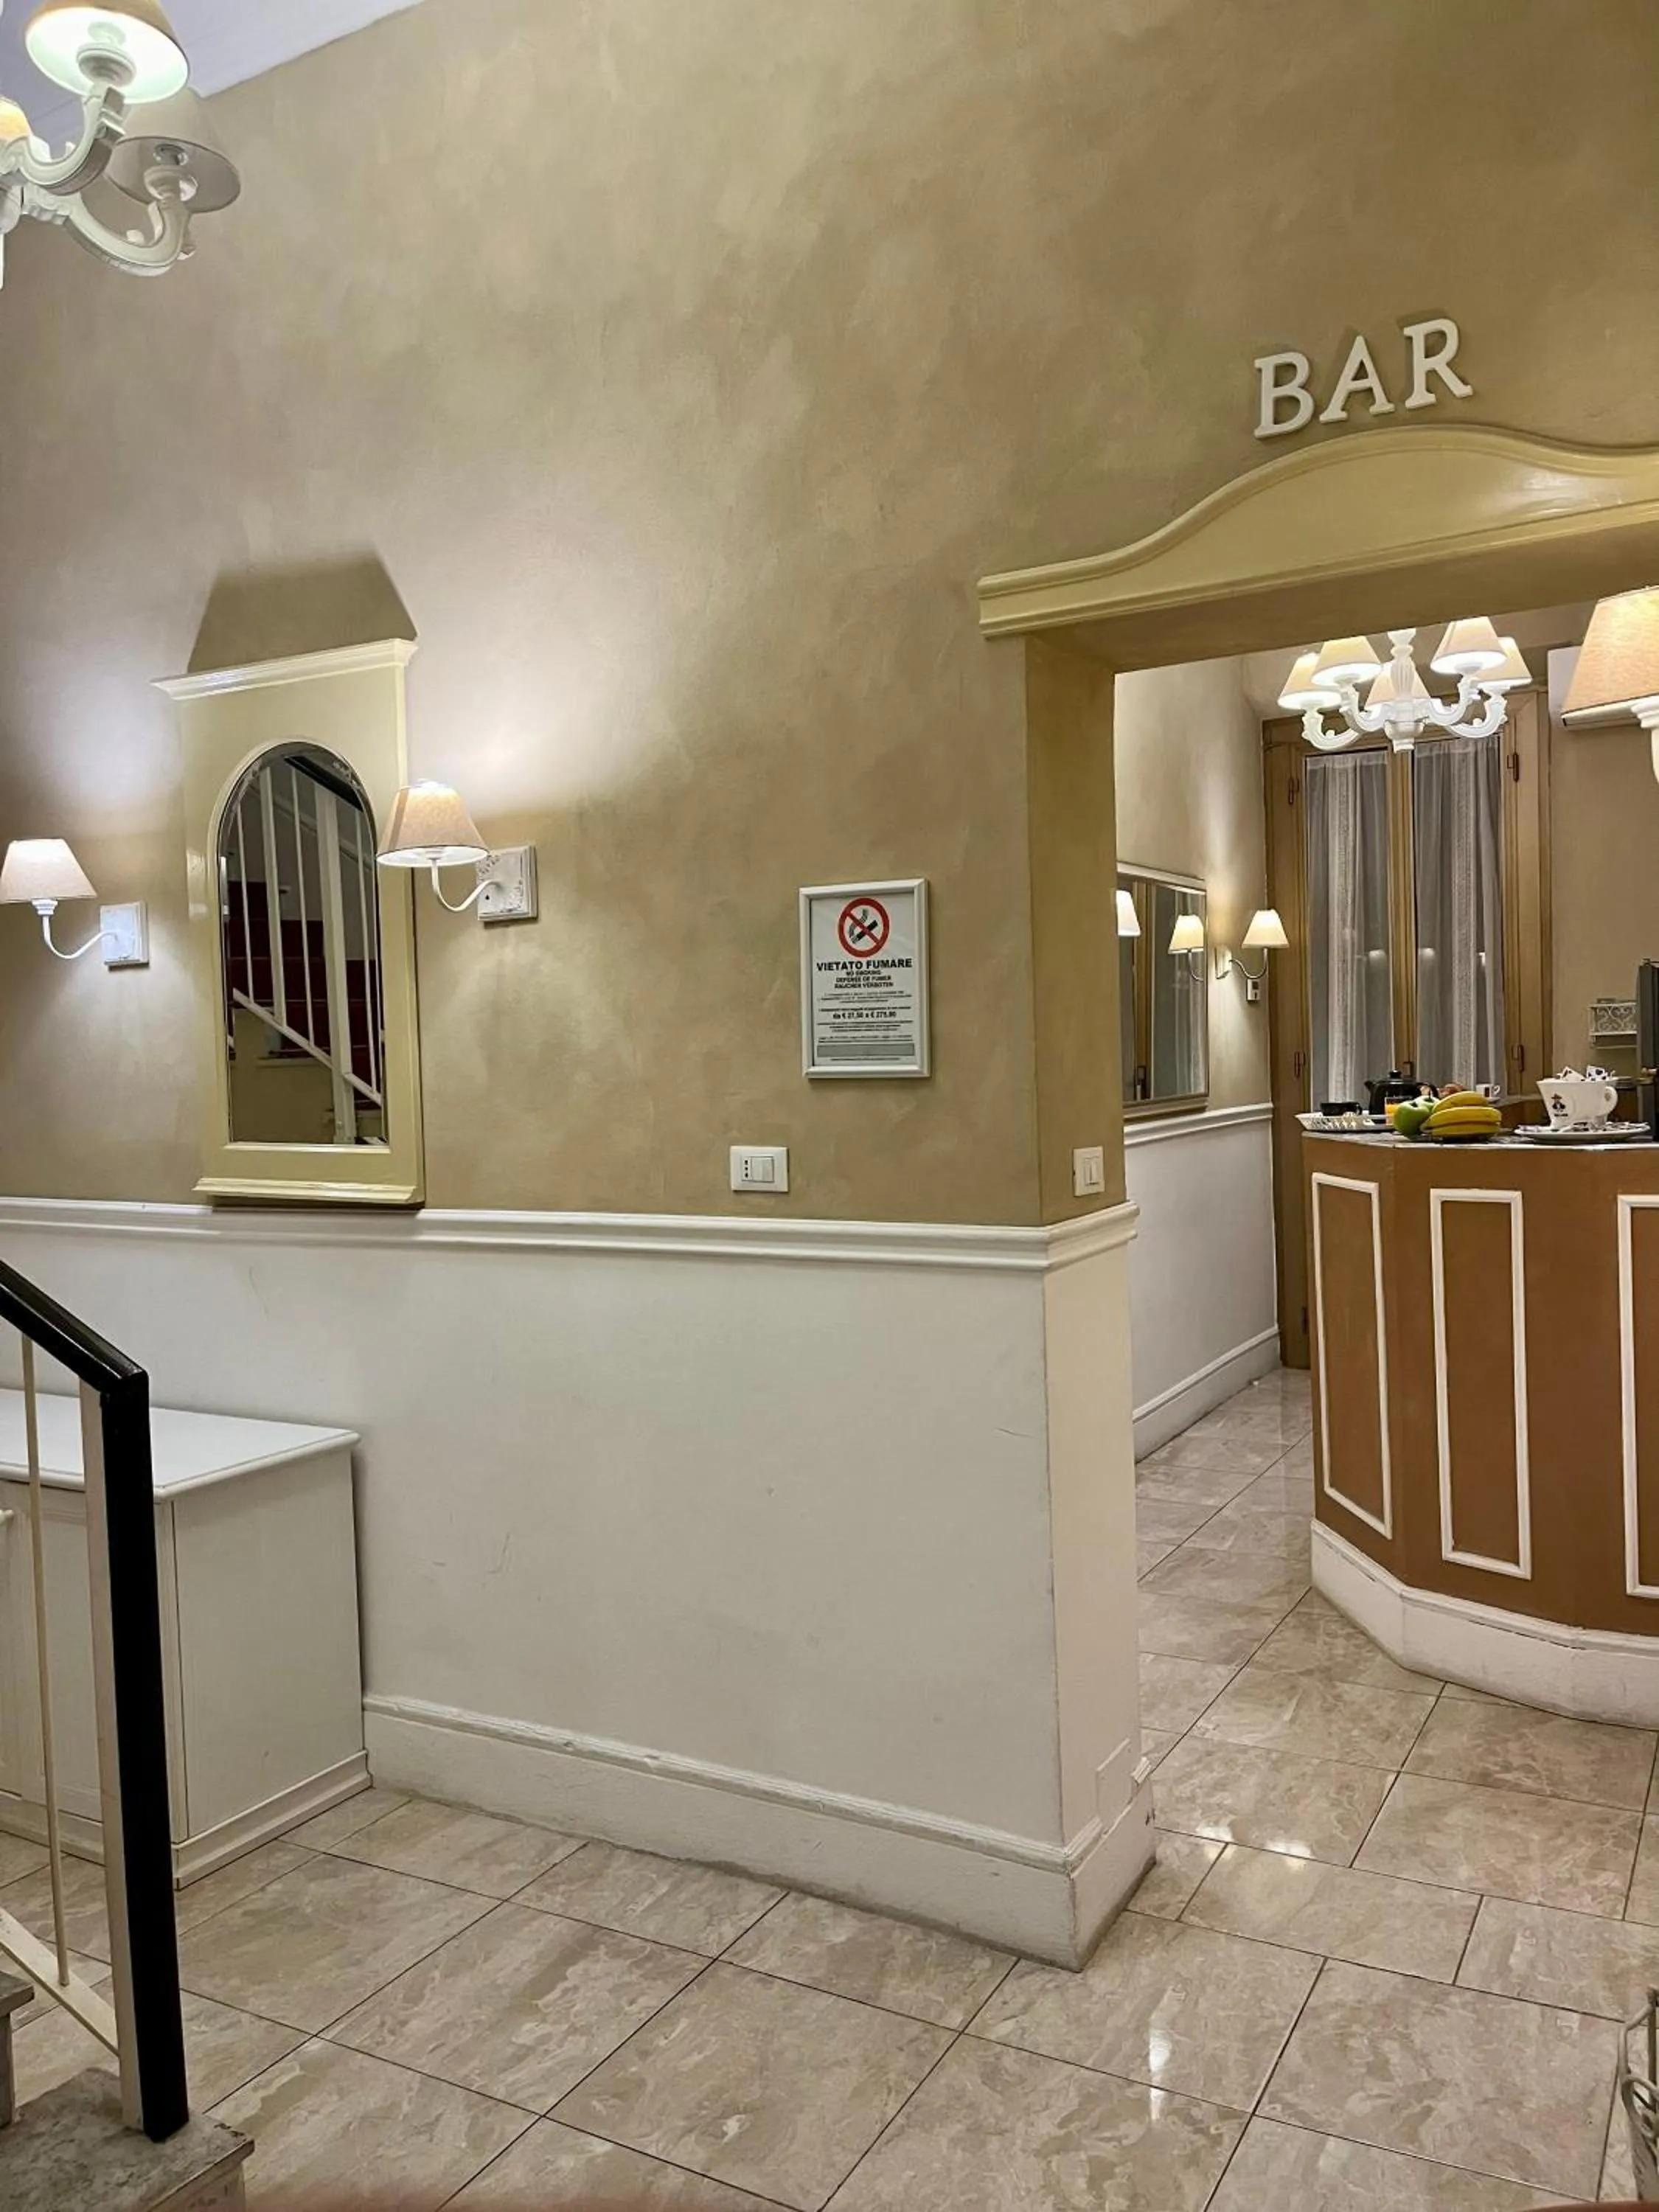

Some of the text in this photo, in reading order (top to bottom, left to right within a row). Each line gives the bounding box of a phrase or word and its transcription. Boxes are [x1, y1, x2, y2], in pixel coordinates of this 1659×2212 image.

[1254, 318, 1473, 439] BAR
[816, 958, 913, 971] VIETATO FUMARE
